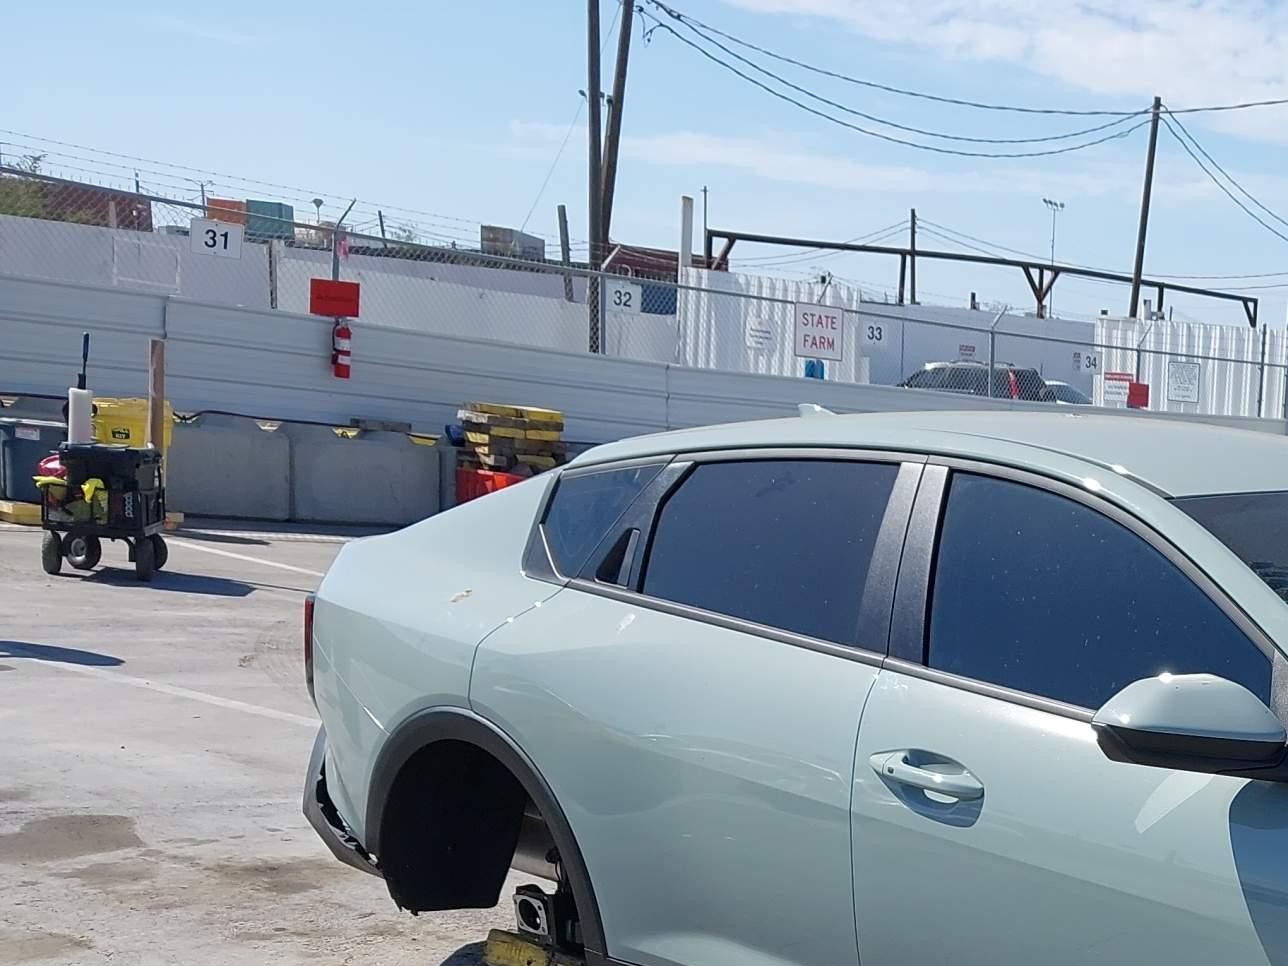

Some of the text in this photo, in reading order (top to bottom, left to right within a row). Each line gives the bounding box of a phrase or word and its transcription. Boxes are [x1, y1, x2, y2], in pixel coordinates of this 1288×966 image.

[204, 229, 228, 250] 31
[613, 290, 632, 307] 32
[802, 312, 837, 330] STATE
[867, 326, 882, 341] 33
[803, 335, 835, 352] FARM
[1085, 355, 1097, 369] 34
